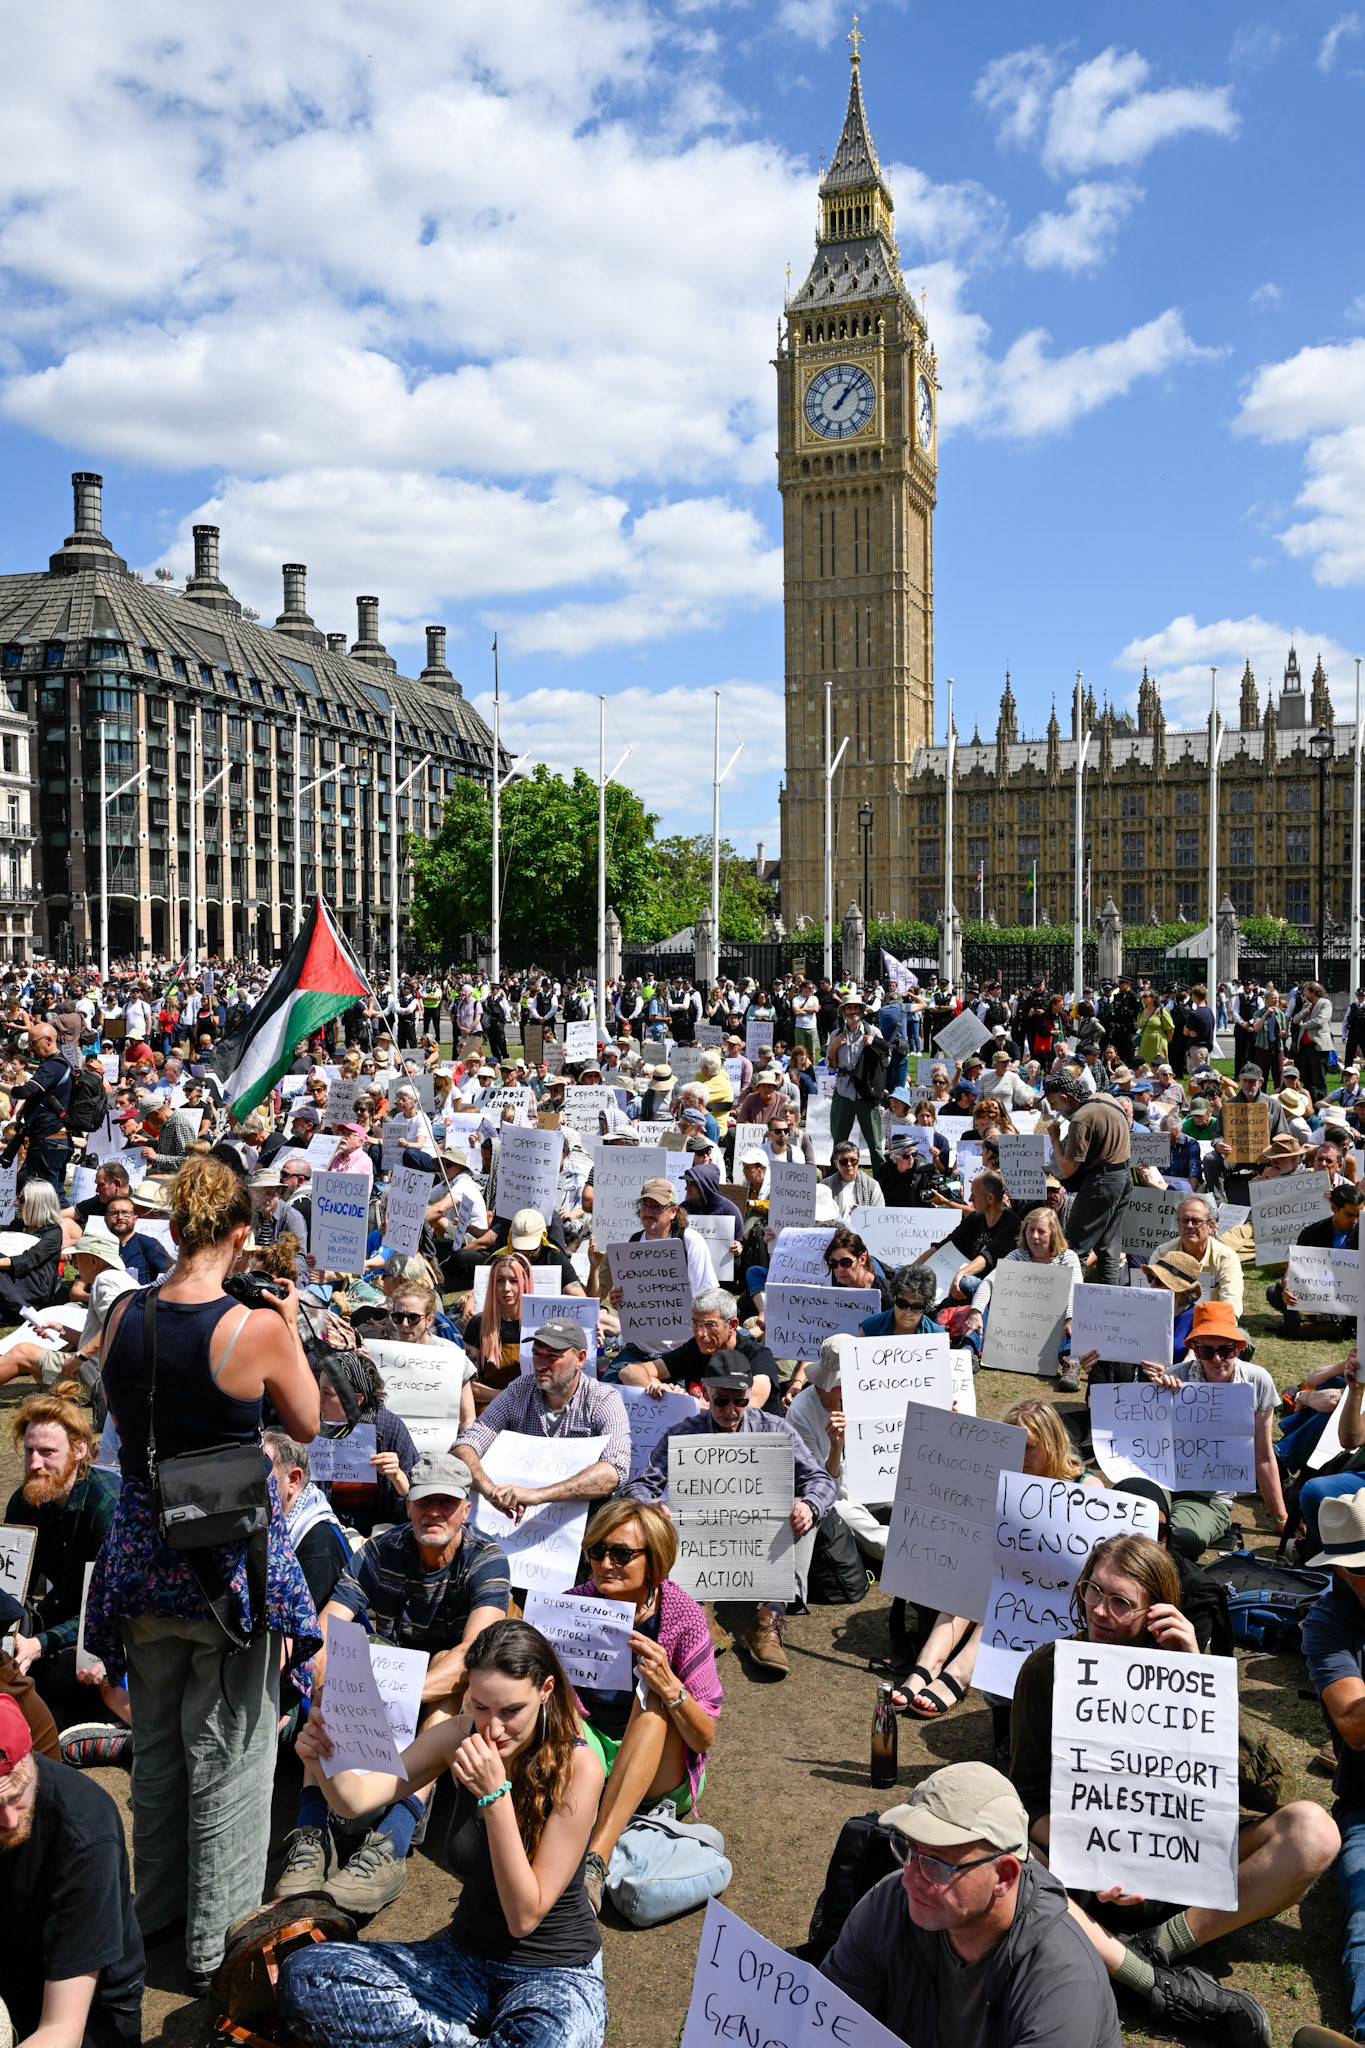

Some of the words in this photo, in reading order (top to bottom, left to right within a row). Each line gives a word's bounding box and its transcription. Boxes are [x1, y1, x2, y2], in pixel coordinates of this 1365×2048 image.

[481, 1090, 487, 1100] I
[489, 1090, 525, 1099] OPPOSE
[565, 1088, 572, 1098] I
[565, 1113, 572, 1122] I
[641, 1125, 673, 1133] OPPOSE
[501, 1132, 507, 1146] I
[513, 1138, 552, 1151] OPPOSE
[501, 1149, 552, 1165] GENOCIDE
[611, 1153, 653, 1164] OPPOSE
[501, 1166, 508, 1175] I
[510, 1170, 544, 1183] SUPPORT
[785, 1172, 809, 1183] OPPOSE
[1001, 1168, 1044, 1178] SUPPORT
[315, 1175, 320, 1192] I
[326, 1178, 366, 1198] OPPOSE
[401, 1170, 424, 1195] RIGHT
[504, 1177, 551, 1195] PALESTINE
[1273, 1177, 1325, 1196] OPPOSE
[503, 1191, 542, 1209] ACTION
[775, 1186, 811, 1201] GENOCIDE
[317, 1196, 365, 1218] GENOCIDE
[785, 1205, 814, 1219] SUPPORT
[1128, 1201, 1153, 1213] POSE
[1260, 1200, 1321, 1219] GENOCIDE
[596, 1215, 644, 1229] PALESTIN
[862, 1209, 871, 1229] I
[877, 1214, 919, 1225] OPPOSE
[328, 1233, 359, 1245] SUPPORT
[389, 1219, 418, 1249] PROTEST
[1260, 1225, 1266, 1237] I
[327, 1246, 358, 1255] PALESTINE
[791, 1235, 828, 1252] OPPOSE
[327, 1256, 355, 1265] ACTION
[629, 1249, 678, 1260] OPPOSE
[1291, 1256, 1327, 1265] OPPOSE
[1004, 1271, 1016, 1281] I
[1022, 1275, 1056, 1285] OPPOSE
[1294, 1278, 1343, 1288] SUPPORT
[637, 1283, 689, 1294] SUPPORT
[1000, 1288, 1053, 1301] GENOCIDE
[1087, 1287, 1112, 1296] OPPOSE
[1122, 1290, 1158, 1301] GENOCIDE
[542, 1304, 587, 1319] OPPOSE
[619, 1298, 684, 1310] PALESTINE
[789, 1295, 830, 1306] OPPOSE
[834, 1297, 877, 1315] GENOCIDE
[798, 1314, 841, 1331] SUPPORT
[1000, 1307, 1009, 1317] I
[1019, 1310, 1060, 1323] SUPPORT
[1103, 1309, 1133, 1318] SUPPORT
[994, 1326, 1039, 1340] PALESTINE
[1078, 1321, 1121, 1332] PALESTINE
[996, 1342, 1028, 1355] ACTION
[1106, 1336, 1139, 1346] ACTION
[379, 1353, 387, 1368] I
[393, 1354, 448, 1371] OPPOSE
[854, 1346, 860, 1371] I
[872, 1347, 938, 1366] OPPOSE
[385, 1375, 443, 1392] GENOCIDE
[858, 1376, 936, 1391] GENOCIDE
[1112, 1384, 1125, 1405] I
[1140, 1384, 1225, 1406] OPPOSE
[912, 1412, 930, 1433] I
[949, 1421, 1012, 1450] OPPOSE
[678, 1449, 685, 1466] I
[694, 1447, 760, 1464] OPPOSE
[1108, 1438, 1118, 1459] I
[1131, 1438, 1228, 1459] SUPPORT
[315, 1462, 355, 1471] PALESTINE
[917, 1444, 998, 1480] GENOCIDE
[1202, 1463, 1249, 1482] ACTION
[676, 1477, 764, 1495] GENOCIDE
[904, 1476, 918, 1492] I
[927, 1483, 990, 1511] SUPPORT
[1002, 1475, 1008, 1517] I
[1019, 1481, 1150, 1529] OPPOSE
[677, 1509, 685, 1526] I
[695, 1508, 772, 1526] SUPPORT
[903, 1505, 982, 1544] PALESTINE
[487, 1521, 566, 1553] PALESTINE
[681, 1539, 764, 1557] PALESTINE
[896, 1537, 959, 1571] ACTION
[695, 1570, 754, 1588] ACTION
[543, 1597, 576, 1609] OPPOSE
[580, 1604, 633, 1623] GENOCIDE
[542, 1623, 594, 1642] SUPPORT
[1077, 1658, 1099, 1686] I
[1127, 1663, 1217, 1698] OPPOSE
[324, 1700, 378, 1718] SUPPORT
[1075, 1696, 1216, 1734] GENOCIDE
[327, 1722, 391, 1741] ALESTINE
[335, 1740, 392, 1762] ACTION
[1070, 1747, 1089, 1773] I
[1110, 1750, 1226, 1789] SUPPORT
[1071, 1782, 1206, 1823] PALESTINE
[1086, 1826, 1200, 1864] ACTION
[710, 1924, 727, 1968] I
[738, 1949, 859, 2047] OPPOSE
